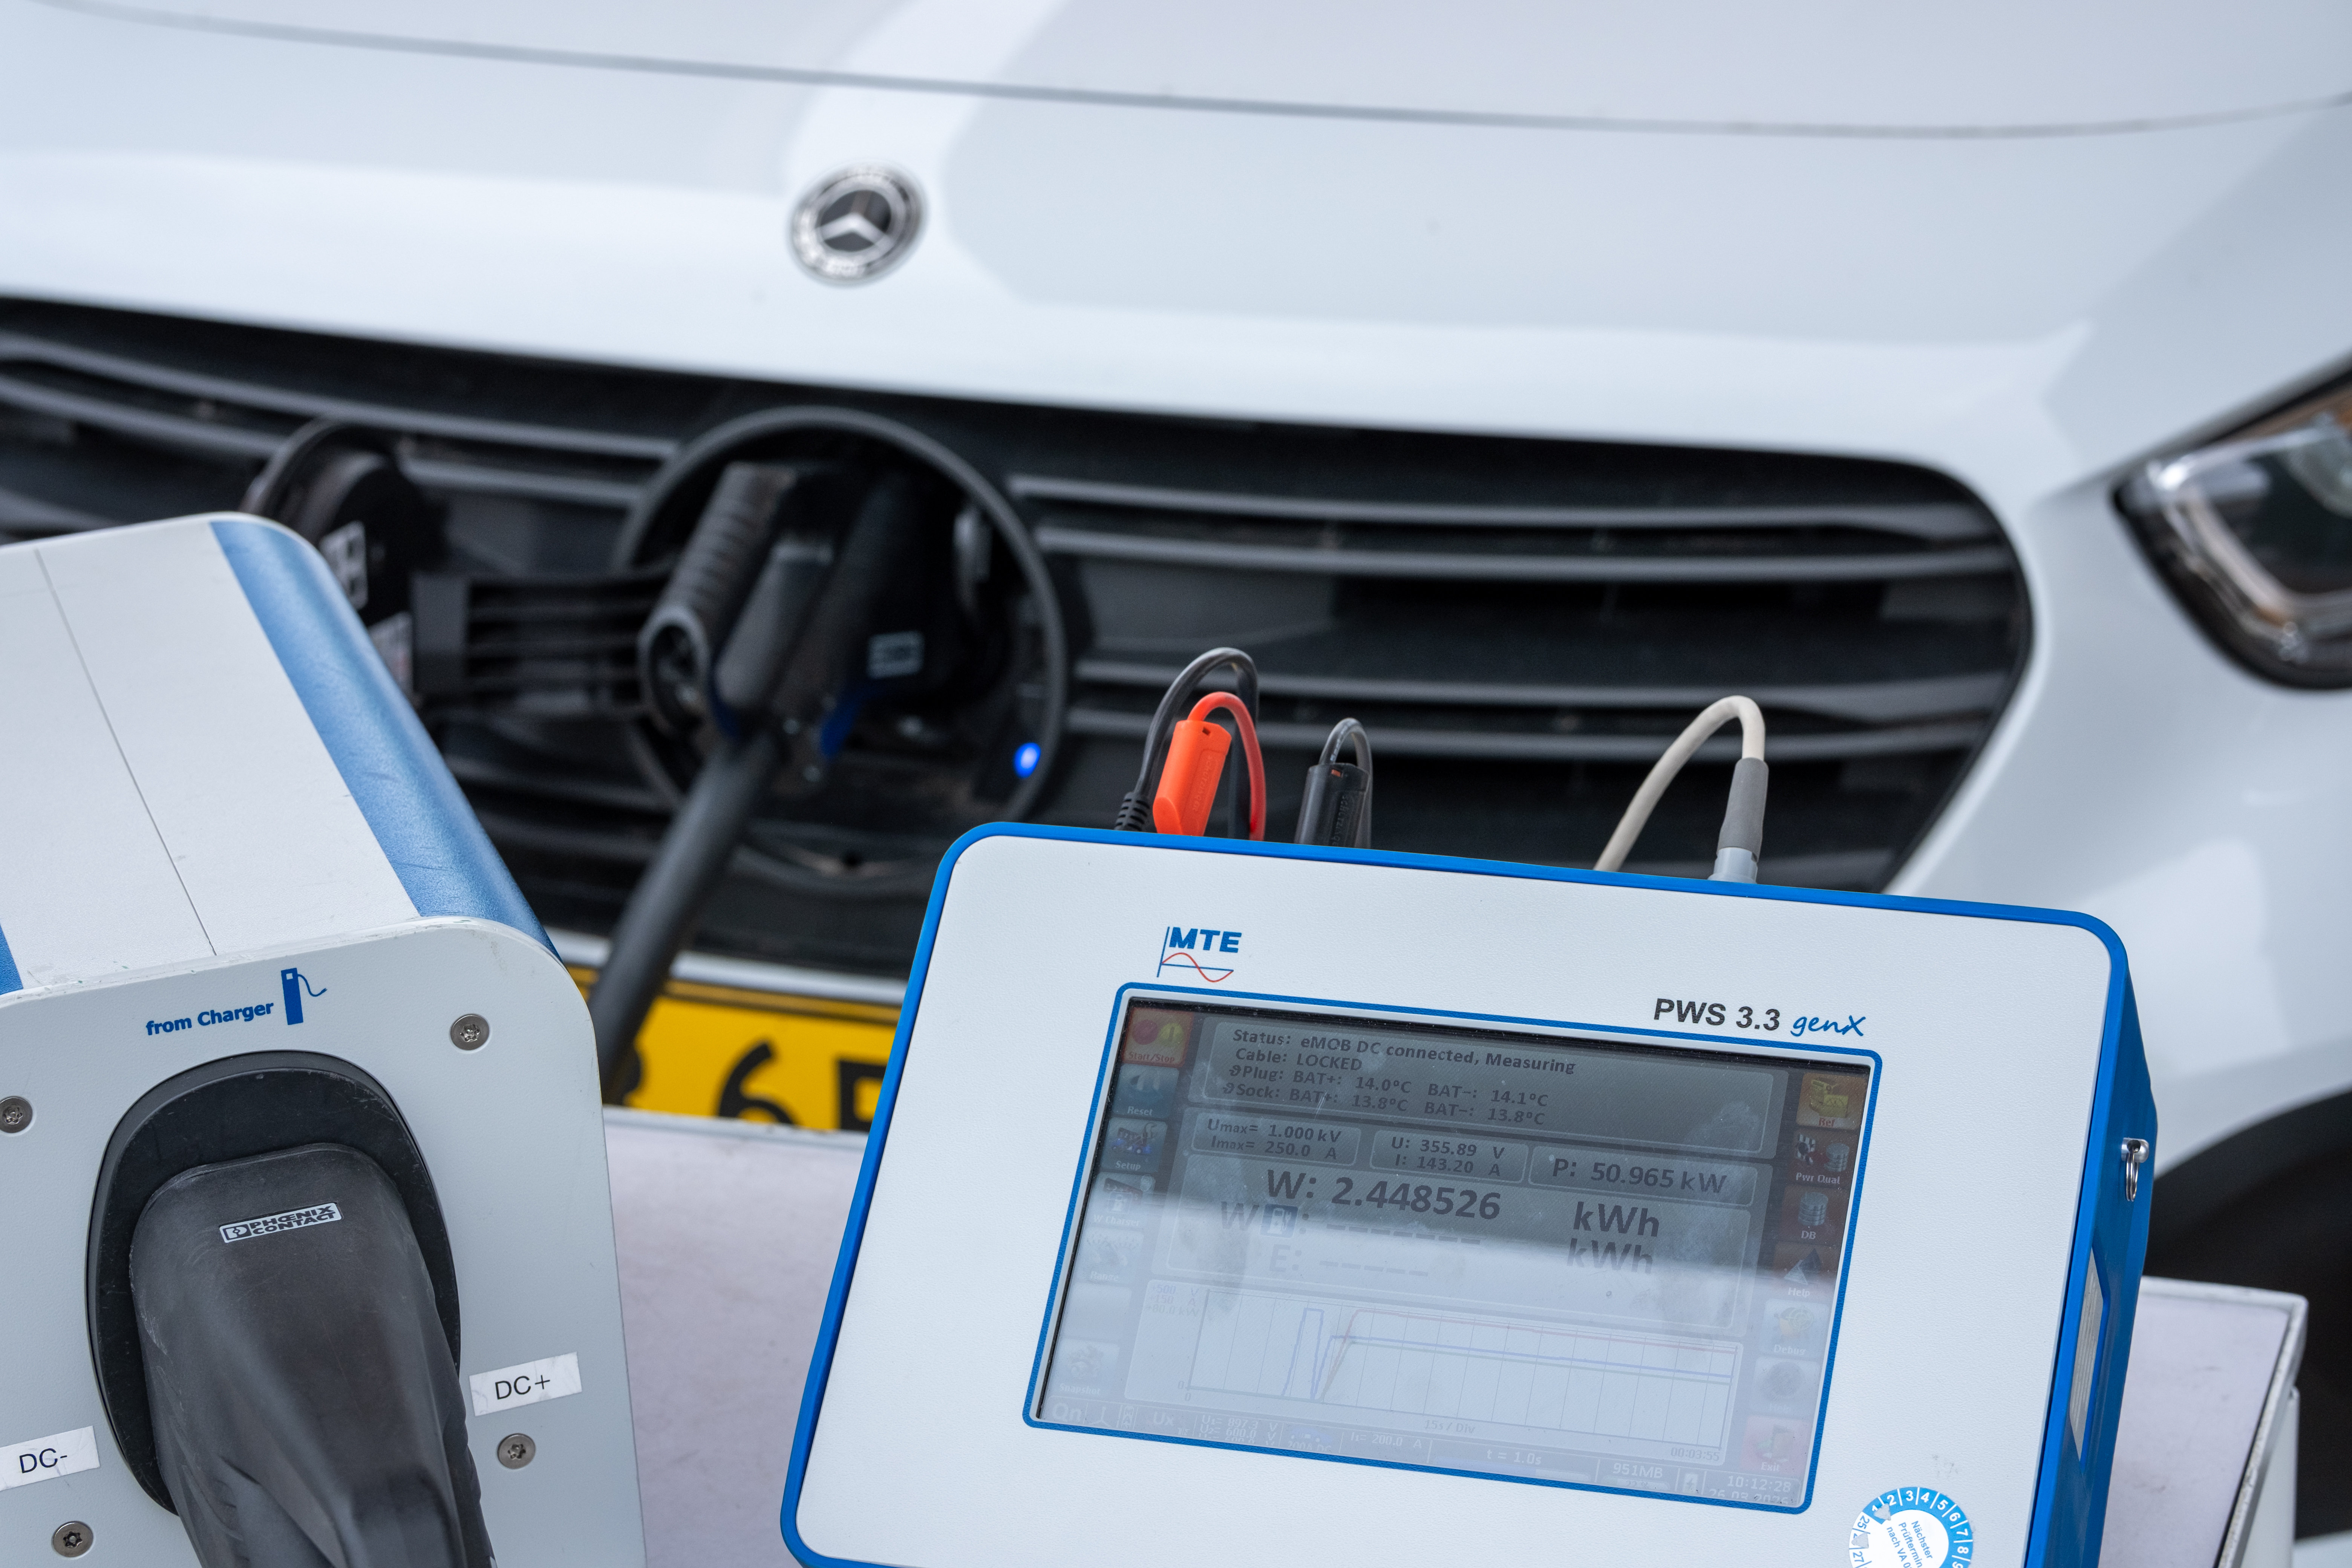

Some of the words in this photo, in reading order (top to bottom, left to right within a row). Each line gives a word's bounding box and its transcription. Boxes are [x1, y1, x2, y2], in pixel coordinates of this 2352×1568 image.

[1169, 927, 1242, 953] MTE
[146, 1017, 192, 1036] from
[198, 1003, 274, 1026] Charger
[1654, 998, 1726, 1026] PWS
[1736, 1006, 1780, 1031] 3.3
[1790, 1015, 1866, 1037] genX
[1129, 1051, 1175, 1063] Start/Stop
[1233, 1029, 1291, 1046] Status:
[1301, 1038, 1351, 1052] eMOB
[1357, 1042, 1381, 1055] DC
[1386, 1045, 1480, 1066] connected,
[1485, 1052, 1576, 1075] Measuring
[1235, 1047, 1287, 1064] Cable:
[1296, 1053, 1362, 1071] LOCKED
[1293, 1070, 1341, 1086] BAT+:
[1289, 1088, 1338, 1103] BAT+:
[1127, 1106, 1153, 1116] Reset
[1818, 1118, 1835, 1128] Ref
[1268, 1124, 1313, 1141] 1.000
[1317, 1128, 1342, 1143] kV
[1265, 1140, 1311, 1157] 250.0
[1324, 1147, 1337, 1159] A
[1391, 1137, 1410, 1149] U:
[1419, 1139, 1477, 1157] 355.89
[1493, 1146, 1505, 1159] V
[1115, 1161, 1141, 1171] Setup
[1416, 1156, 1474, 1173] 143.20
[1488, 1164, 1500, 1176] A
[1553, 1159, 1577, 1177] P:
[1591, 1162, 1674, 1188] 50.965
[1680, 1171, 1727, 1193] kW
[1796, 1172, 1814, 1182] Pwr
[1818, 1175, 1840, 1184] Qual
[1267, 1169, 1317, 1200] W:
[1331, 1176, 1501, 1220] 2.448526
[1573, 1201, 1658, 1237] kWh
[253, 1212, 335, 1234] CONTACT
[1801, 1231, 1816, 1240] DB
[1566, 1238, 1653, 1274] kWh
[1090, 1271, 1119, 1282] Range
[1190, 1288, 1199, 1297] V
[1788, 1288, 1810, 1298] Help
[1188, 1298, 1196, 1307] A
[1773, 1344, 1806, 1356] Debug
[494, 1373, 551, 1401] DC+
[1059, 1383, 1100, 1395] Snapshot
[1052, 1402, 1082, 1422] Qn
[1228, 1418, 1259, 1430] 897.3
[1269, 1422, 1278, 1431] V
[1424, 1419, 1444, 1430] 15s
[1456, 1423, 1475, 1434] Div
[1226, 1427, 1257, 1439] 600.0
[1268, 1432, 1276, 1441] V
[1372, 1435, 1403, 1447] 200.0
[1413, 1439, 1422, 1449] A
[18, 1448, 68, 1474] DC-
[1513, 1451, 1542, 1466] 1.0s
[1671, 1447, 1720, 1462] 00:03:55
[1613, 1462, 1663, 1478] 951MB
[1761, 1462, 1779, 1472] Exit
[1727, 1475, 1791, 1493] 10:12:28
[1887, 1494, 1897, 1506] 2
[1905, 1490, 1913, 1501] 3
[1921, 1492, 1930, 1503] 4
[1937, 1500, 1948, 1510] 5
[1949, 1512, 1961, 1522] 6
[1857, 1515, 1870, 1529] 25
[1886, 1527, 1901, 1548] nach
[1897, 1548, 1907, 1562] VA
[1899, 1522, 1923, 1568] Prüftermin
[1911, 1521, 1933, 1559] Nächster
[1853, 1551, 1865, 1562] 27
